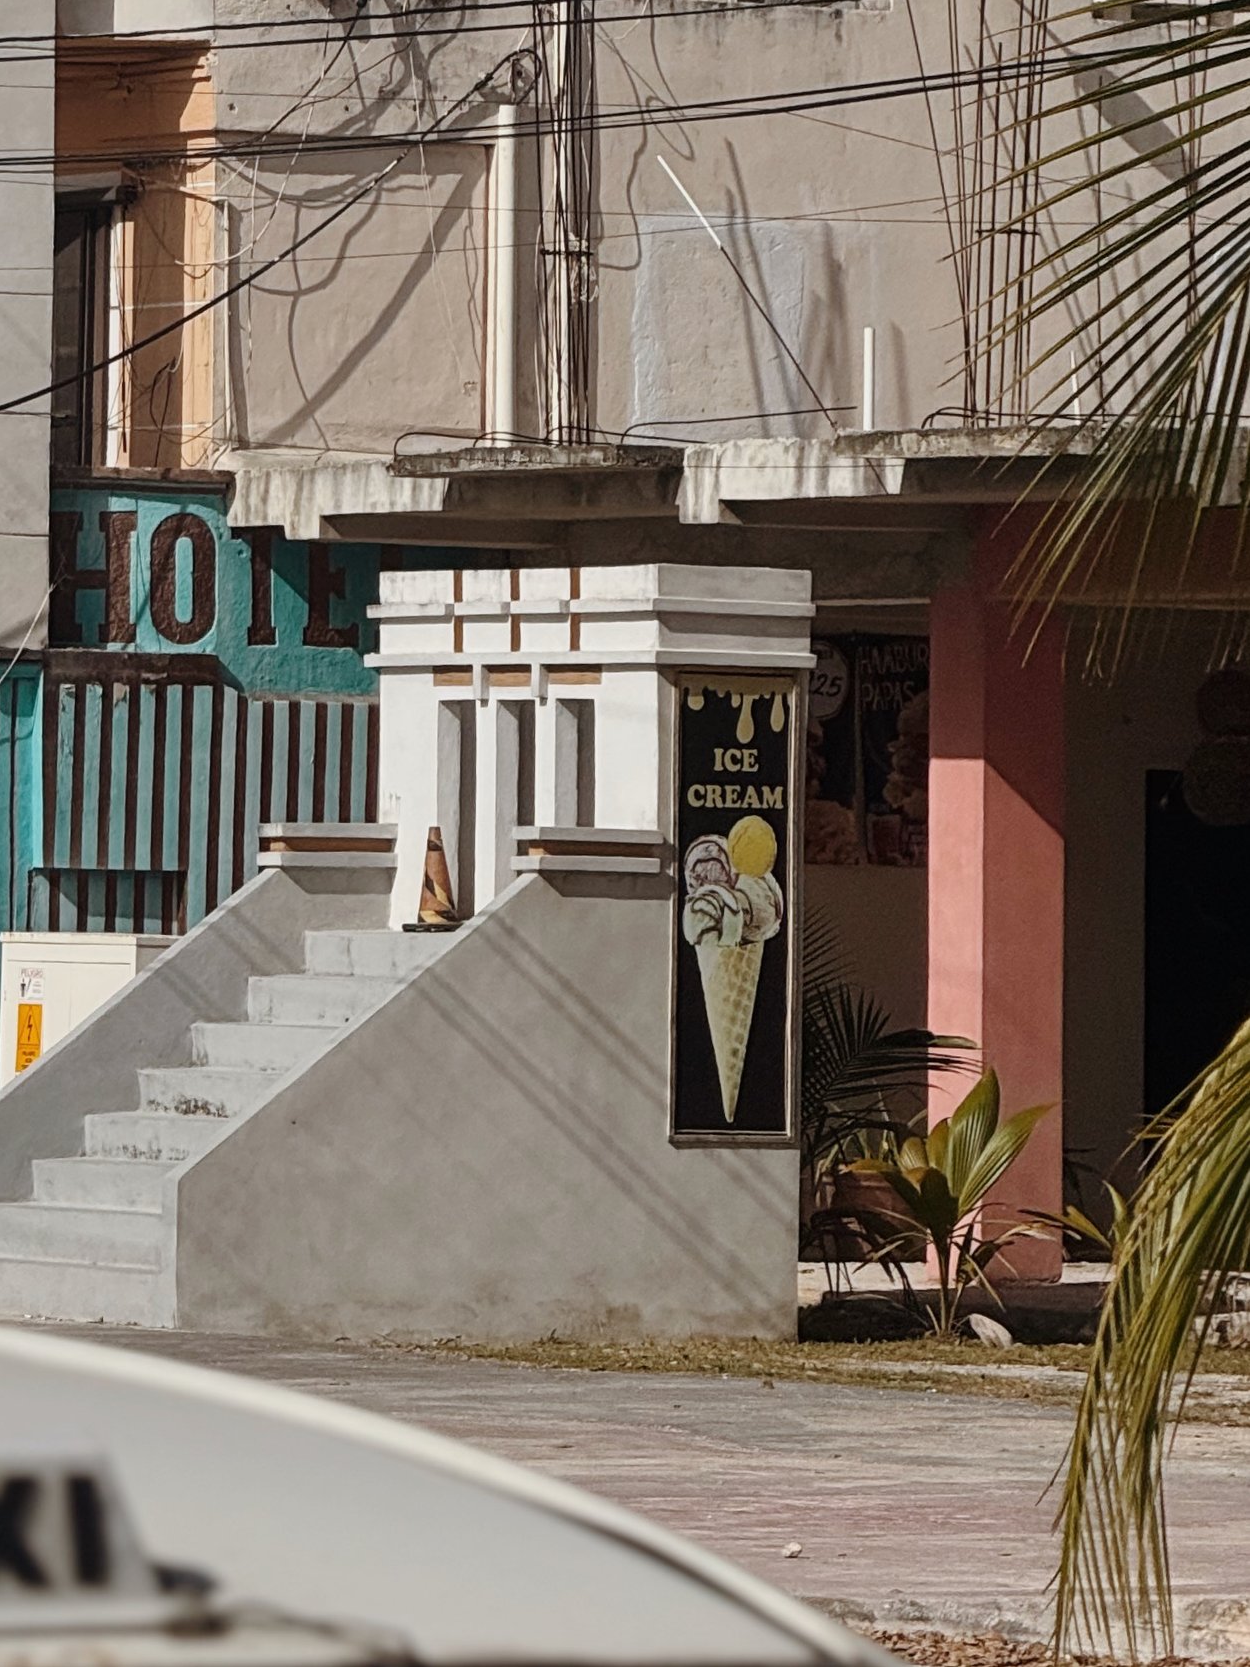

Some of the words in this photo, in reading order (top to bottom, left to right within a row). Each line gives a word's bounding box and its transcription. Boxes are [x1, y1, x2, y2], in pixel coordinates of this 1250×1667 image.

[50, 510, 410, 648] HOTE
[713, 747, 759, 772] ICE
[687, 784, 785, 810] CREAM
